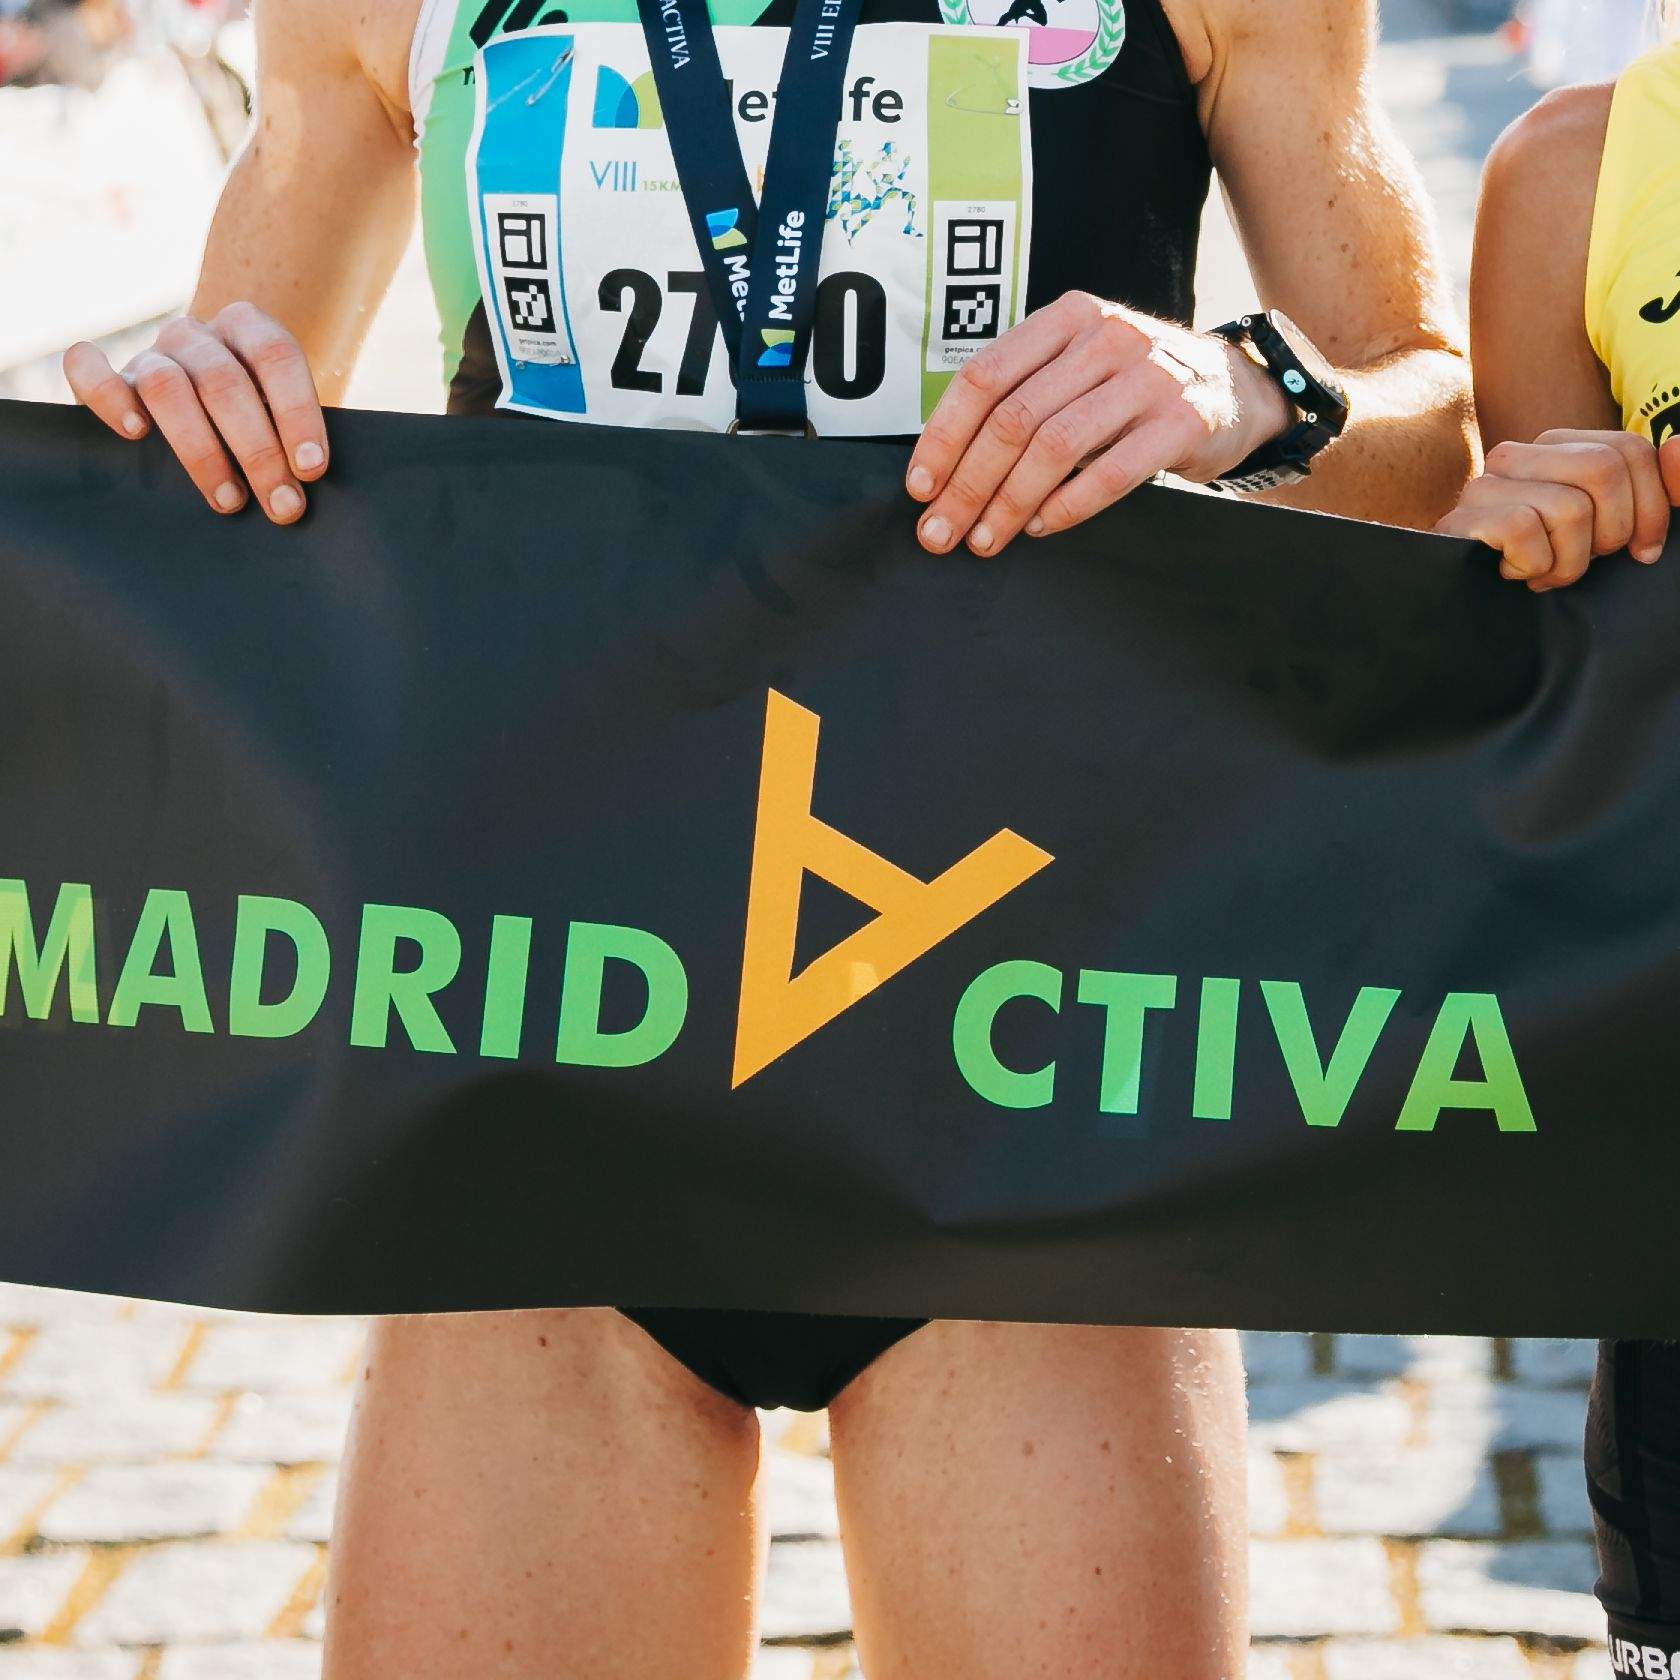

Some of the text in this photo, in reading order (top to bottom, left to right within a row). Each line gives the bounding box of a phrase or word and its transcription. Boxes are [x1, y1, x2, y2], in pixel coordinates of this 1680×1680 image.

[809, 23, 838, 62] VIII
[589, 159, 638, 193] VIII
[768, 210, 806, 321] MetLife
[598, 267, 888, 401] 270
